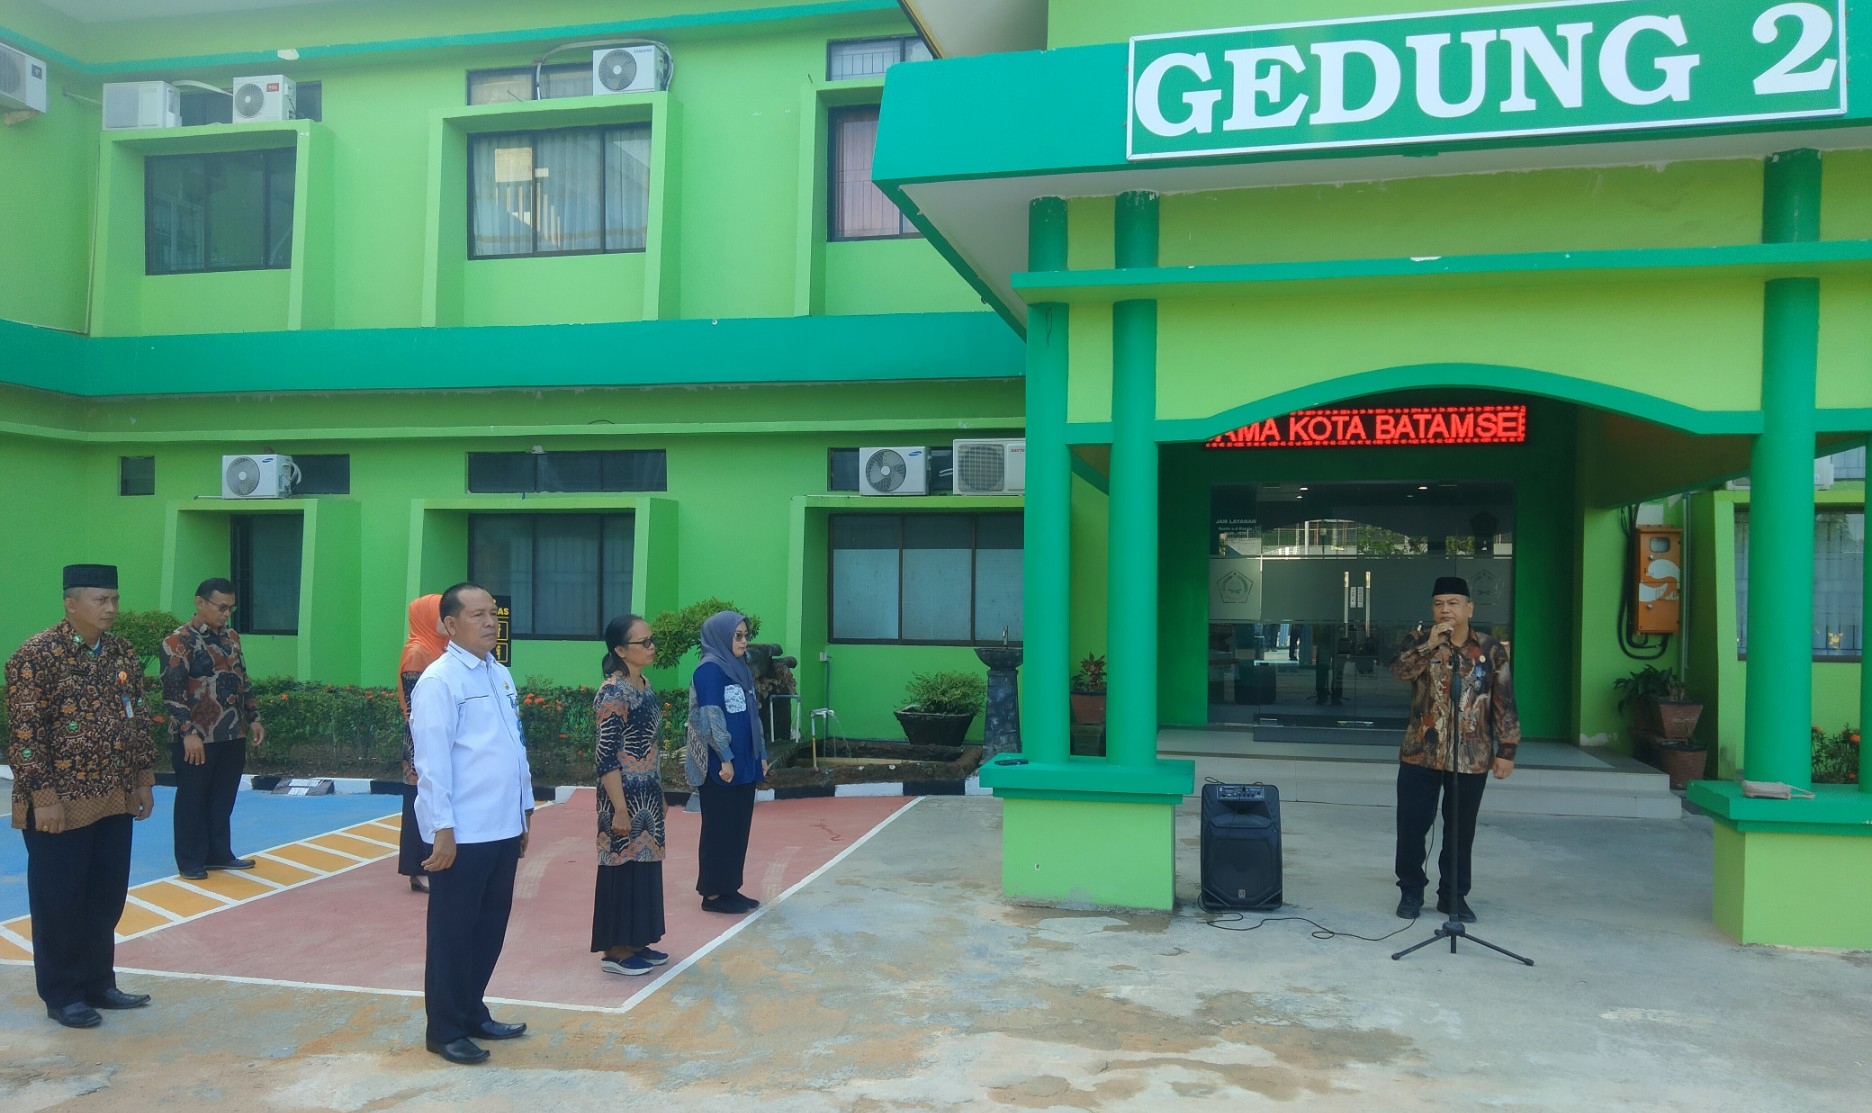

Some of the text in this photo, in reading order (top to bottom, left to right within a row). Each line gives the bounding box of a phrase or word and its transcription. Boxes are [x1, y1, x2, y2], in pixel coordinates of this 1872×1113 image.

[1134, 2, 1838, 138] GEDUNG 2
[1289, 415, 1367, 441] KOTA
